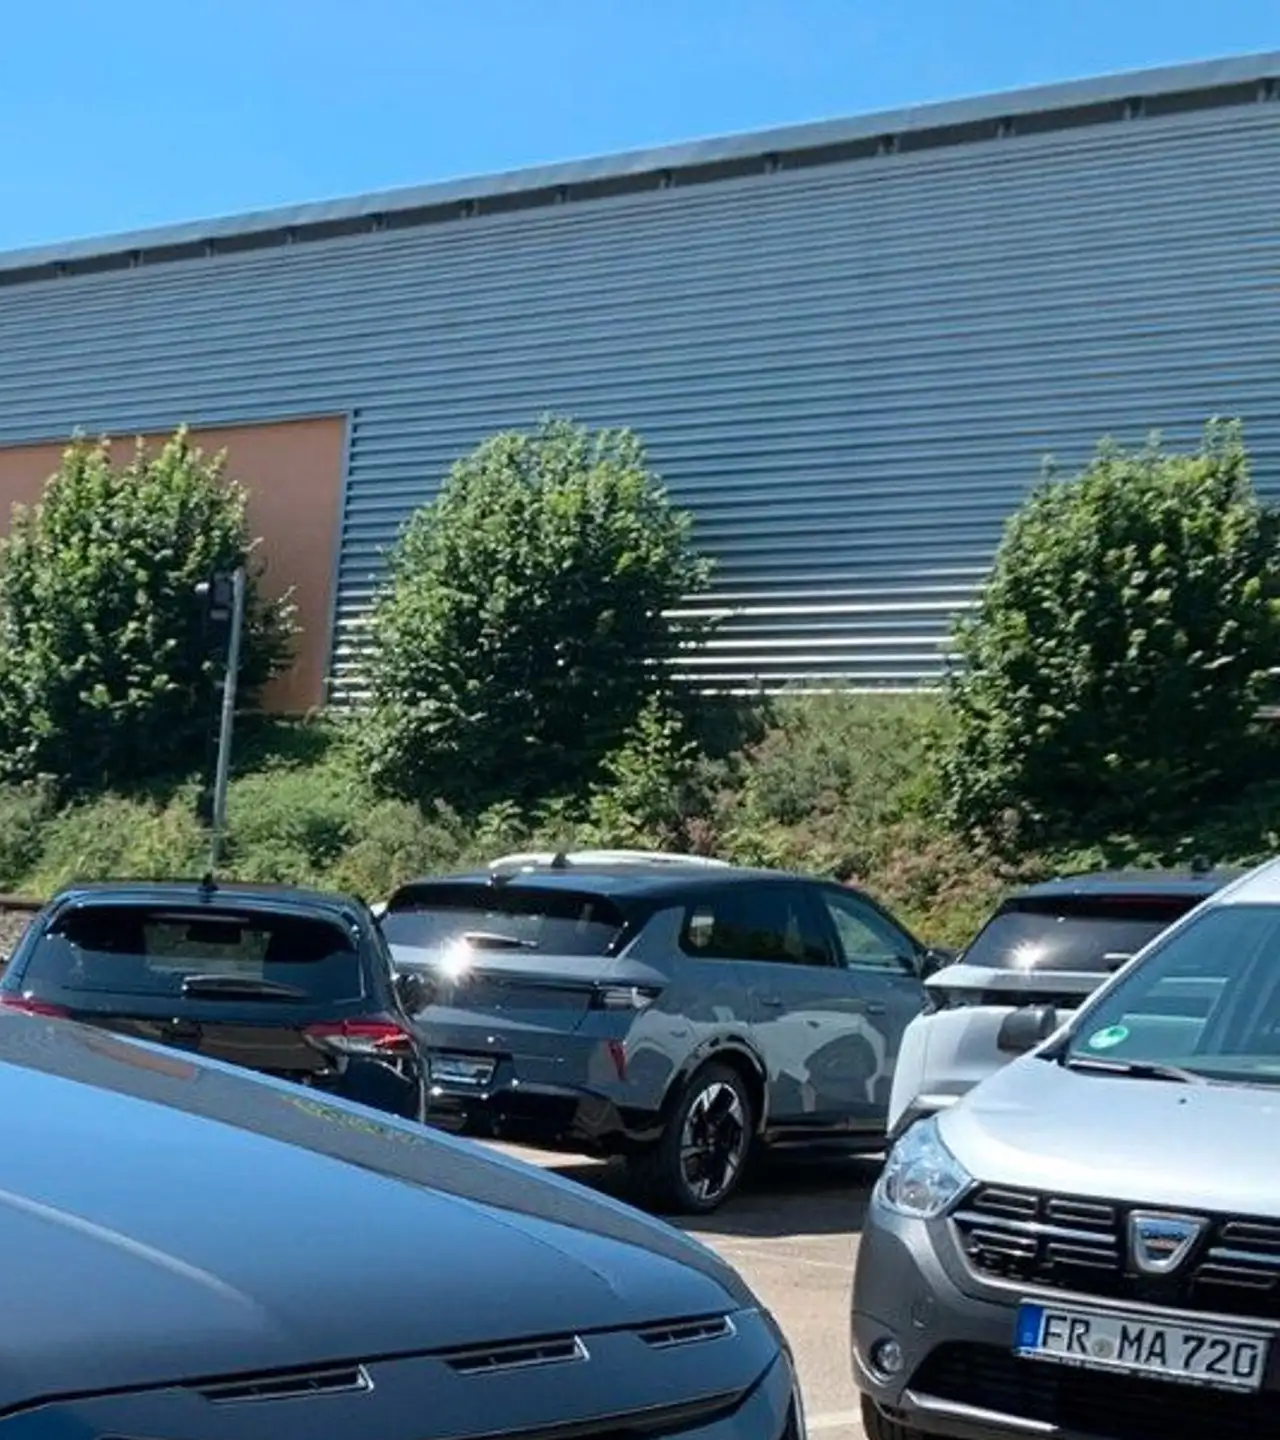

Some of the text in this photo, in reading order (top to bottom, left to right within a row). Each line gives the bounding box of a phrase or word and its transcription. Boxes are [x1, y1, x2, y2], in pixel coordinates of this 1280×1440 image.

[1042, 1315, 1090, 1353] FR
[1117, 1324, 1167, 1366] MA
[1182, 1335, 1258, 1378] 720
